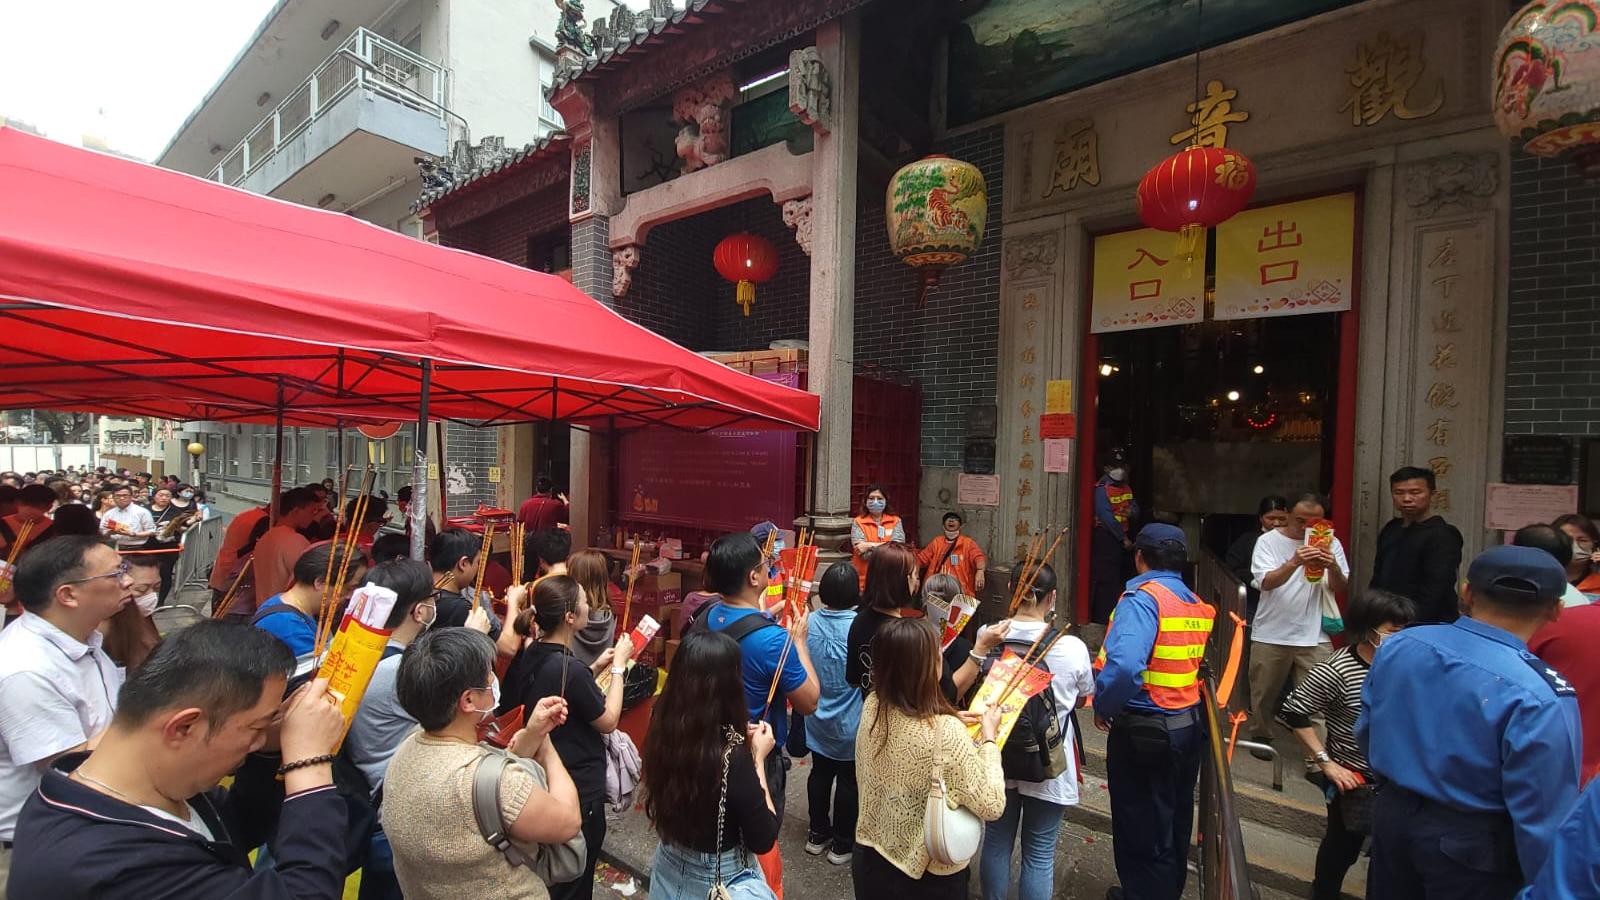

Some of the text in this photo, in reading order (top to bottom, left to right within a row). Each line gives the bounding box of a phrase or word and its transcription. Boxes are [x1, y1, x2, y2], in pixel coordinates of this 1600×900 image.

[1214, 154, 1249, 191] 福
[1127, 248, 1169, 300] 入口
[1257, 220, 1303, 285] 出口
